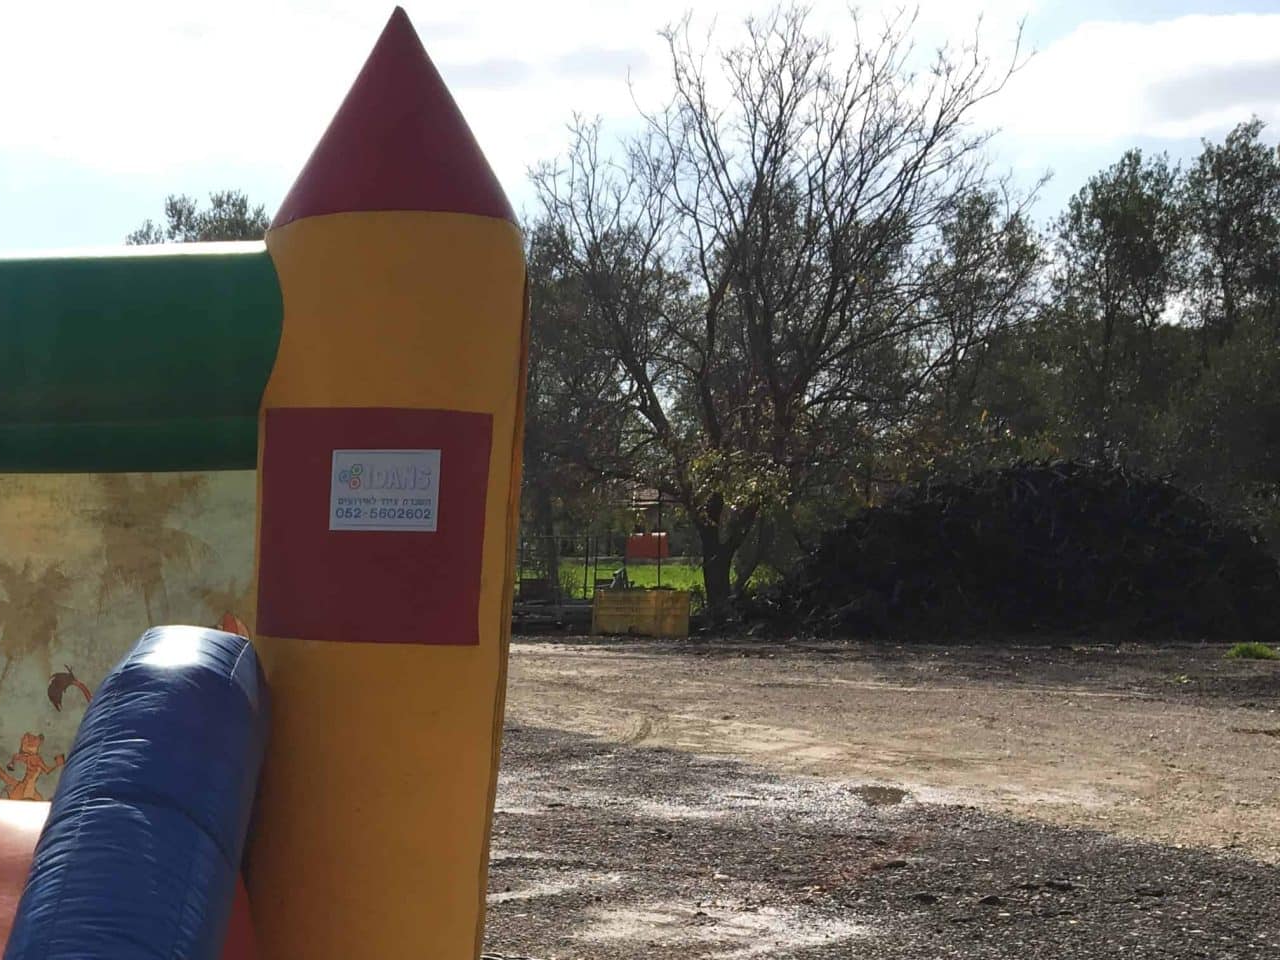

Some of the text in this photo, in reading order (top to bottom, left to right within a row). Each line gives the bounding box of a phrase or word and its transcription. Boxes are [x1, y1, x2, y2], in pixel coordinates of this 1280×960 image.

[337, 496, 376, 506] לאירועים
[402, 497, 432, 506] השכרת
[335, 507, 432, 520] 052-5602602
